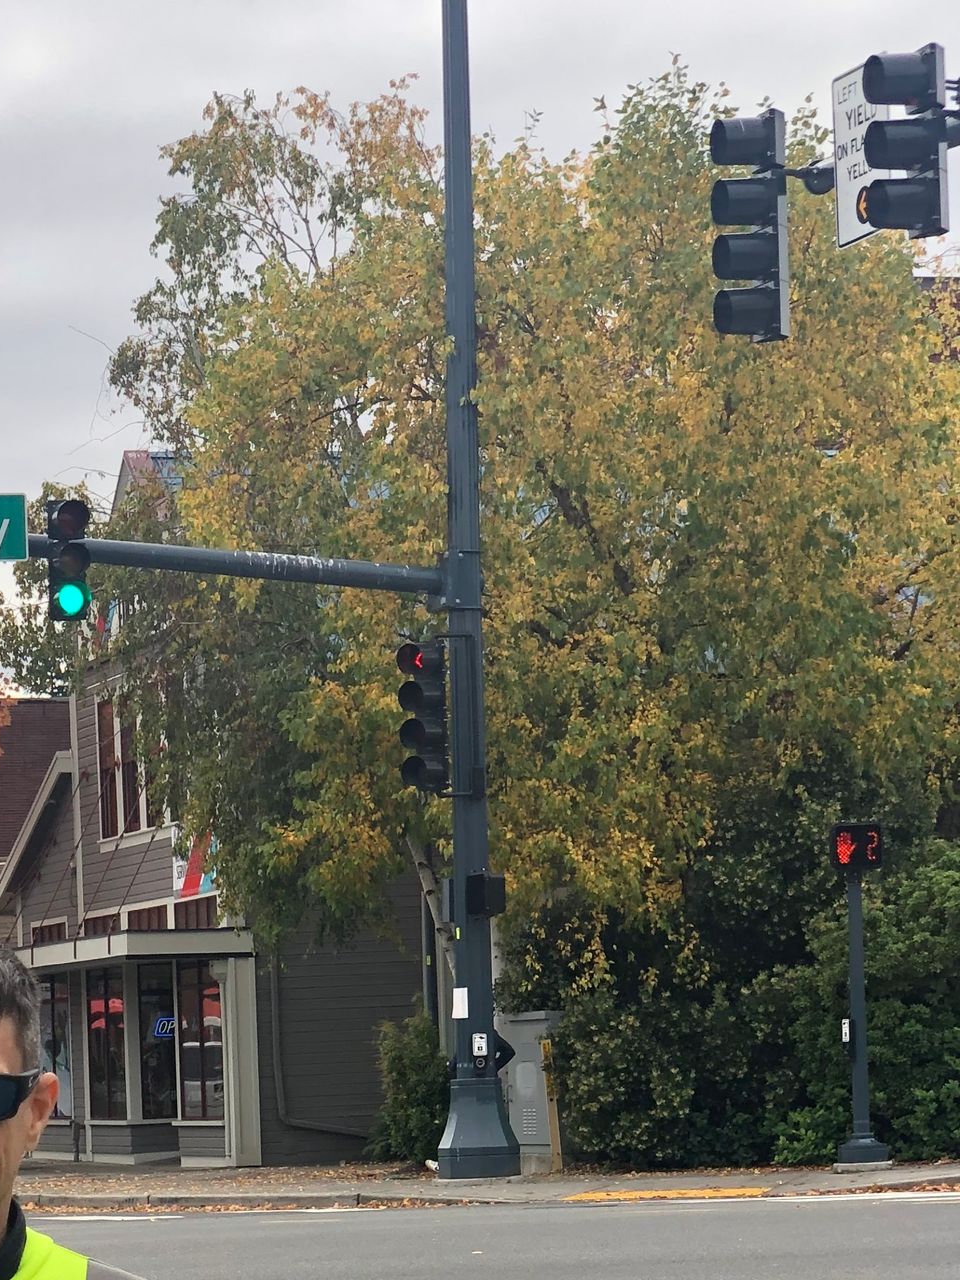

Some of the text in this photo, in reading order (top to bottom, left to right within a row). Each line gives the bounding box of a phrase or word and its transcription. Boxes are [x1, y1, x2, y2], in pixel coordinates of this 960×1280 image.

[837, 81, 858, 105] LEFT
[845, 103, 876, 130] YIELD
[836, 142, 848, 161] ON
